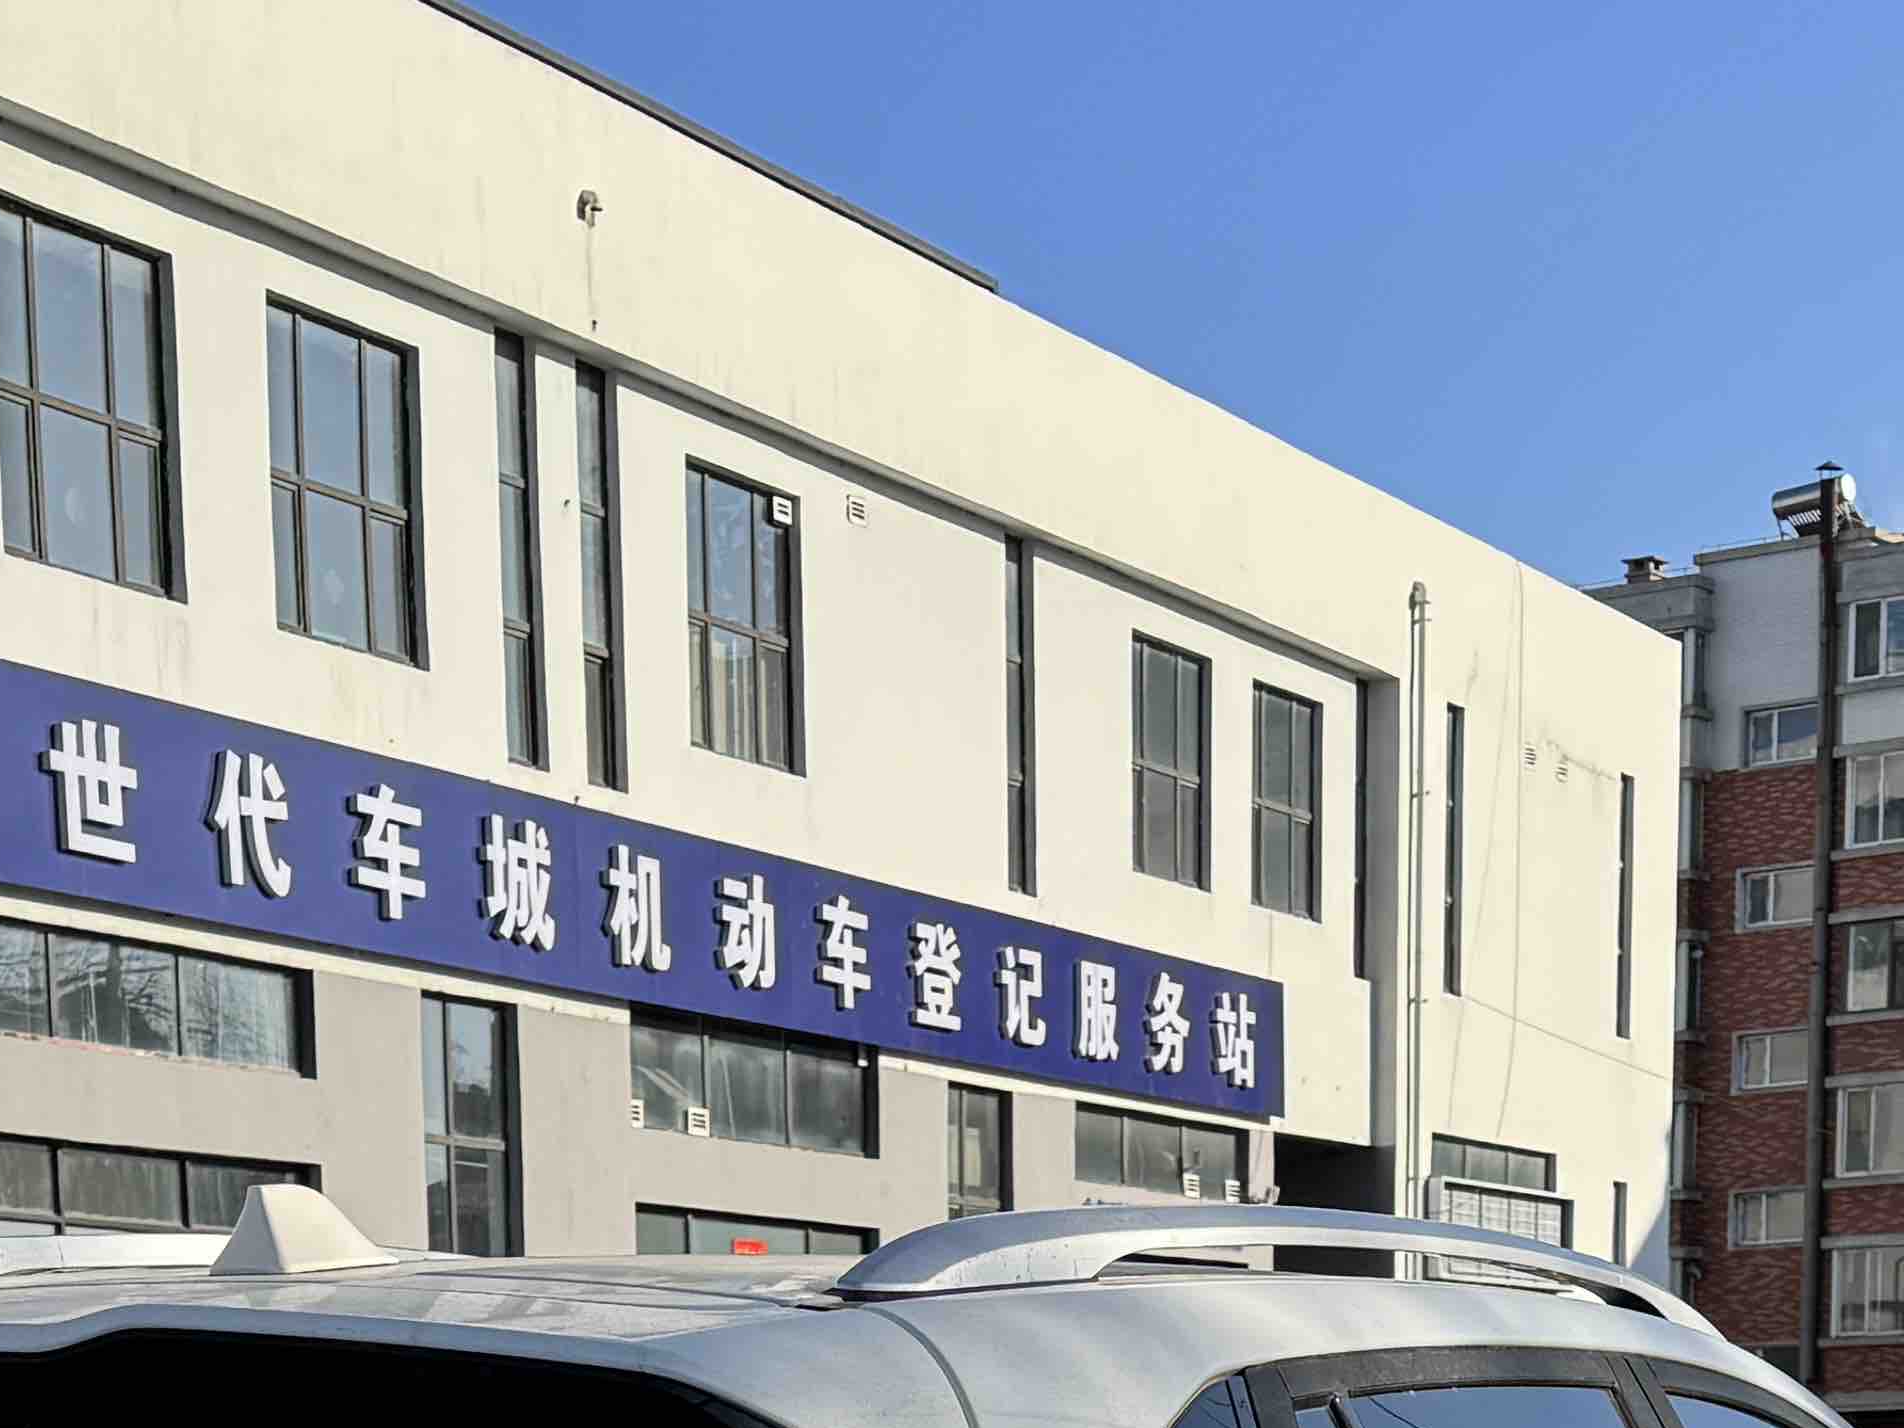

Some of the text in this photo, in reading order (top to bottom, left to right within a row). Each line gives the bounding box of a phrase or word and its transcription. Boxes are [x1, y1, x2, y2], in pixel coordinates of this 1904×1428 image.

[44, 719, 1257, 1090] 世代车城机动车登记服务站
